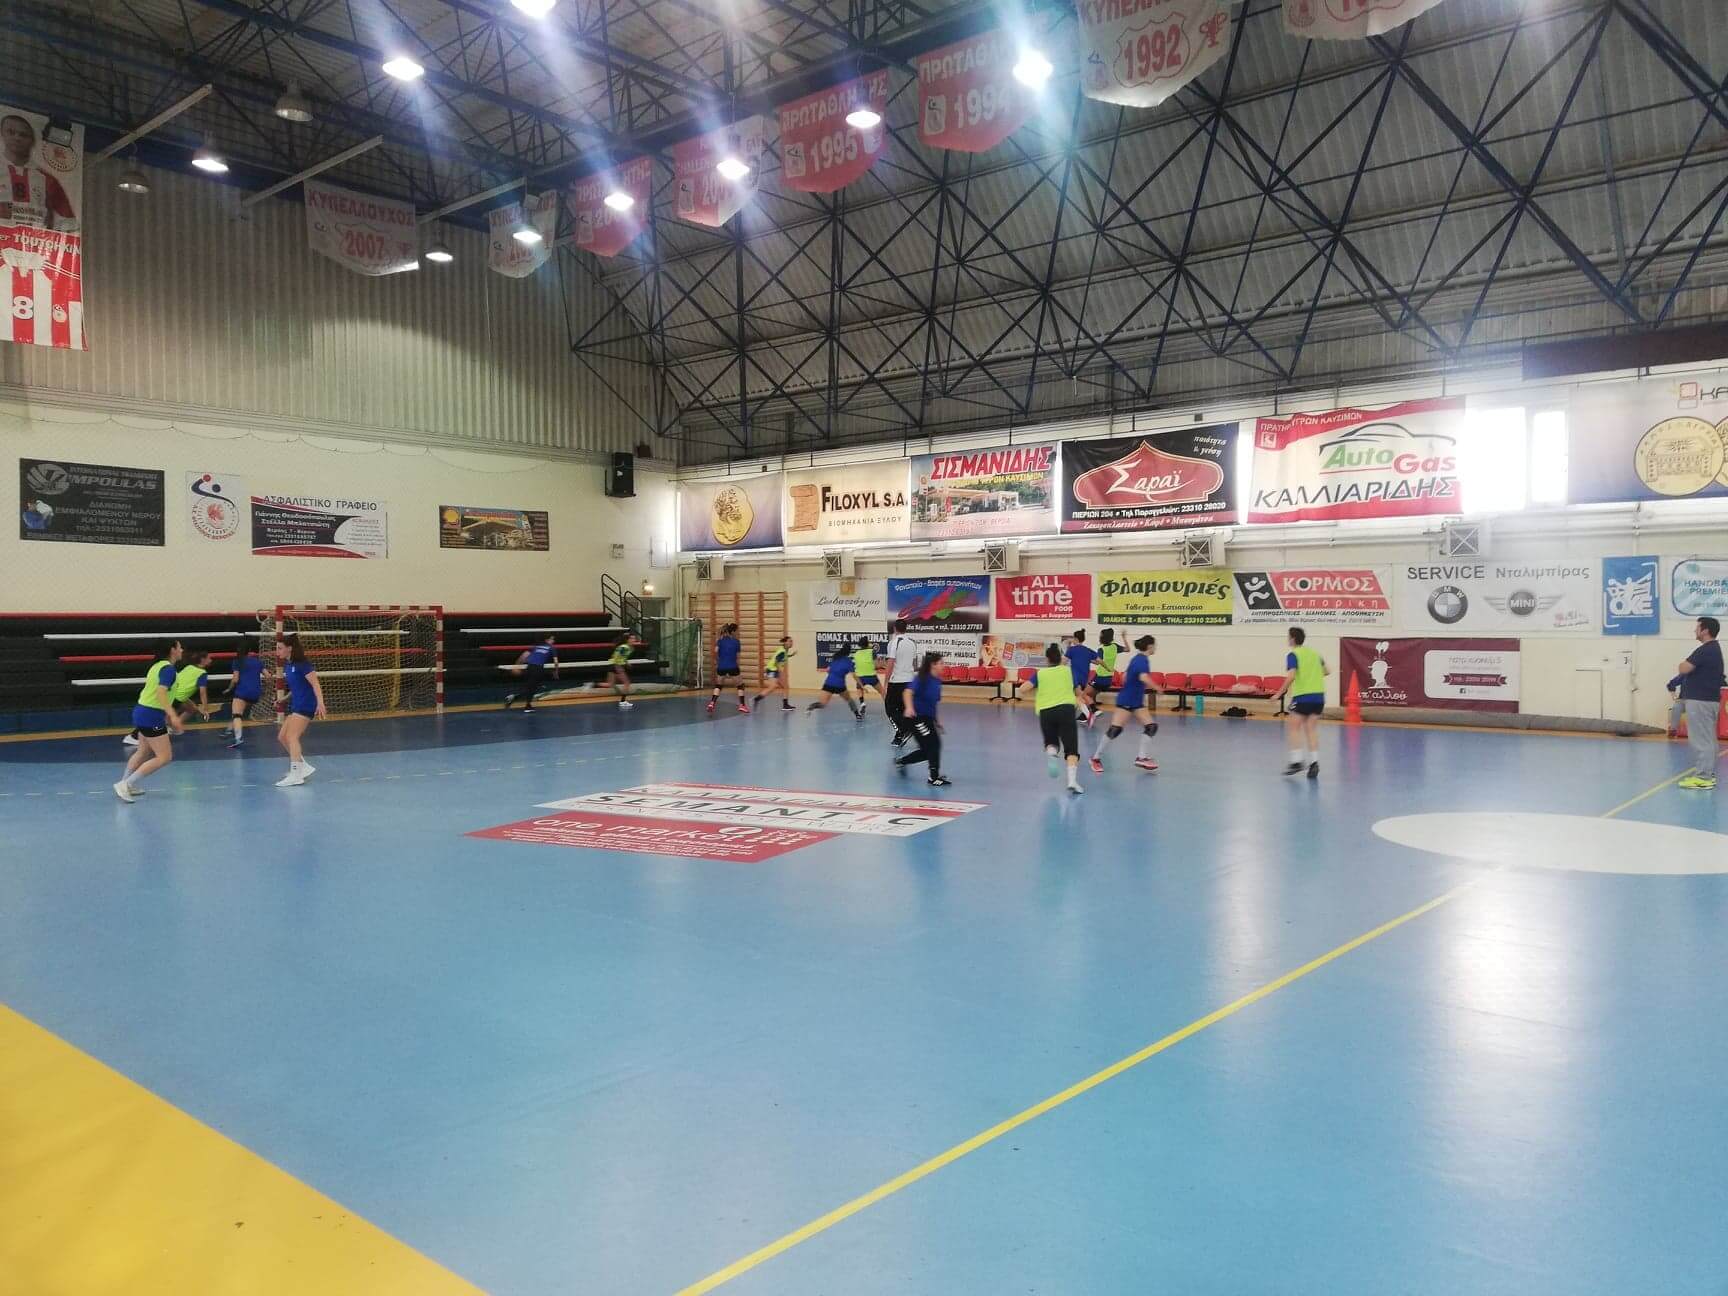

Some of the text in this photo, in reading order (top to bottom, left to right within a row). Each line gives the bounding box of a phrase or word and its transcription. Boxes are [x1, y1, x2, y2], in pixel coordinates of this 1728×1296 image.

[1124, 24, 1182, 81] 1992
[810, 131, 858, 173] 1995
[344, 230, 385, 260] 2007
[13, 296, 34, 320] 8
[1321, 412, 1362, 424] ΚΑΥΣΙΜΩΝ
[931, 446, 1054, 480] ΣΙΣΜΑΝΙΔΗΣ
[1321, 444, 1457, 475] Auto Gas
[263, 495, 377, 511] ΑΣΦΑΛΙΣΤΙΚΟ ΓΡΑΦΕΙΟ
[1254, 476, 1457, 508] ΚΑΛΛΙΑΡΙΔΗΣ
[1031, 575, 1065, 588] ALL
[1283, 576, 1375, 592] ΚΟΡΜΟΣ
[1407, 565, 1590, 580] SERVICE Νταλιμπίρας
[1012, 586, 1073, 606] time
[1100, 577, 1231, 600] Φλαμουριές
[833, 609, 861, 618] ΕΠΙΠΛΑ
[1510, 599, 1535, 608] MINI
[817, 633, 842, 642] ΘΩΜΑΣ
[585, 794, 931, 827] SEMANTIC
[532, 818, 742, 842] one market
